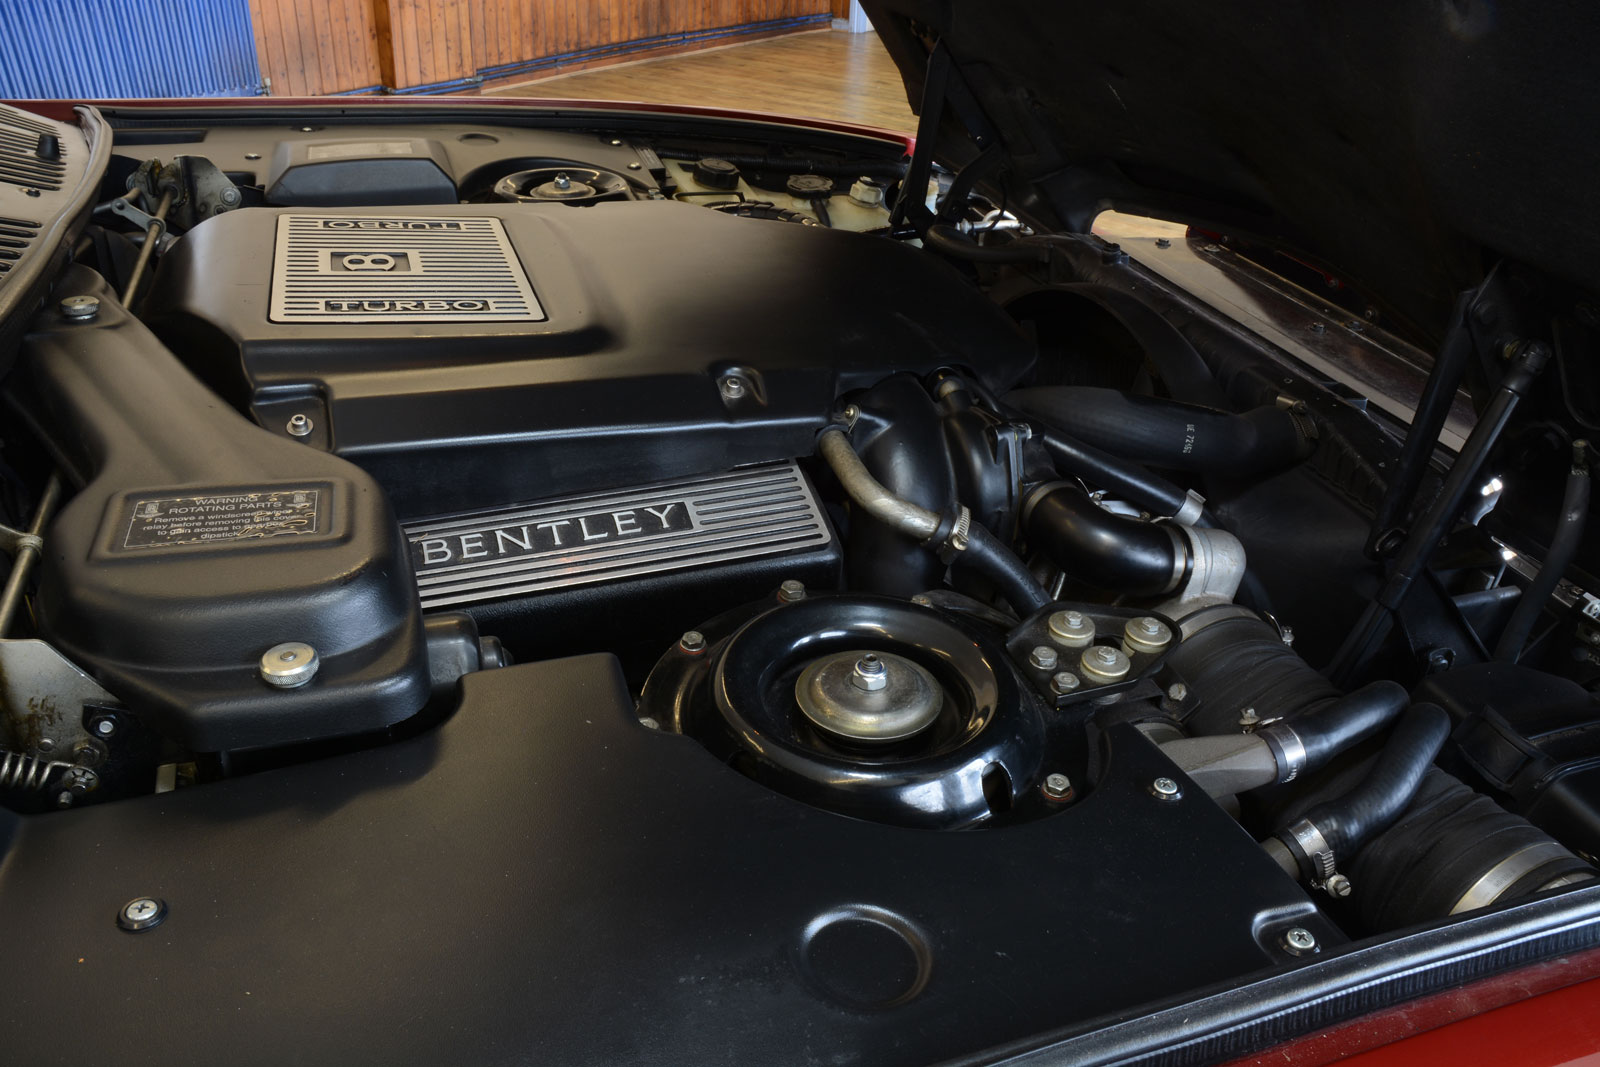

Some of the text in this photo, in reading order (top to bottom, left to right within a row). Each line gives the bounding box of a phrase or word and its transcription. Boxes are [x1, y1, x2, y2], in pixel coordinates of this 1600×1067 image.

[328, 221, 456, 230] TURBO
[331, 301, 483, 311] TURBO
[195, 496, 258, 505] WARNING
[169, 504, 236, 514] ROTATING
[239, 501, 282, 509] PARTS
[154, 515, 196, 523] Remove
[207, 511, 264, 520] windscreen
[204, 518, 250, 526] removing
[169, 528, 191, 536] gain
[200, 531, 239, 540] dipstick
[421, 504, 675, 565] BENTLEY
